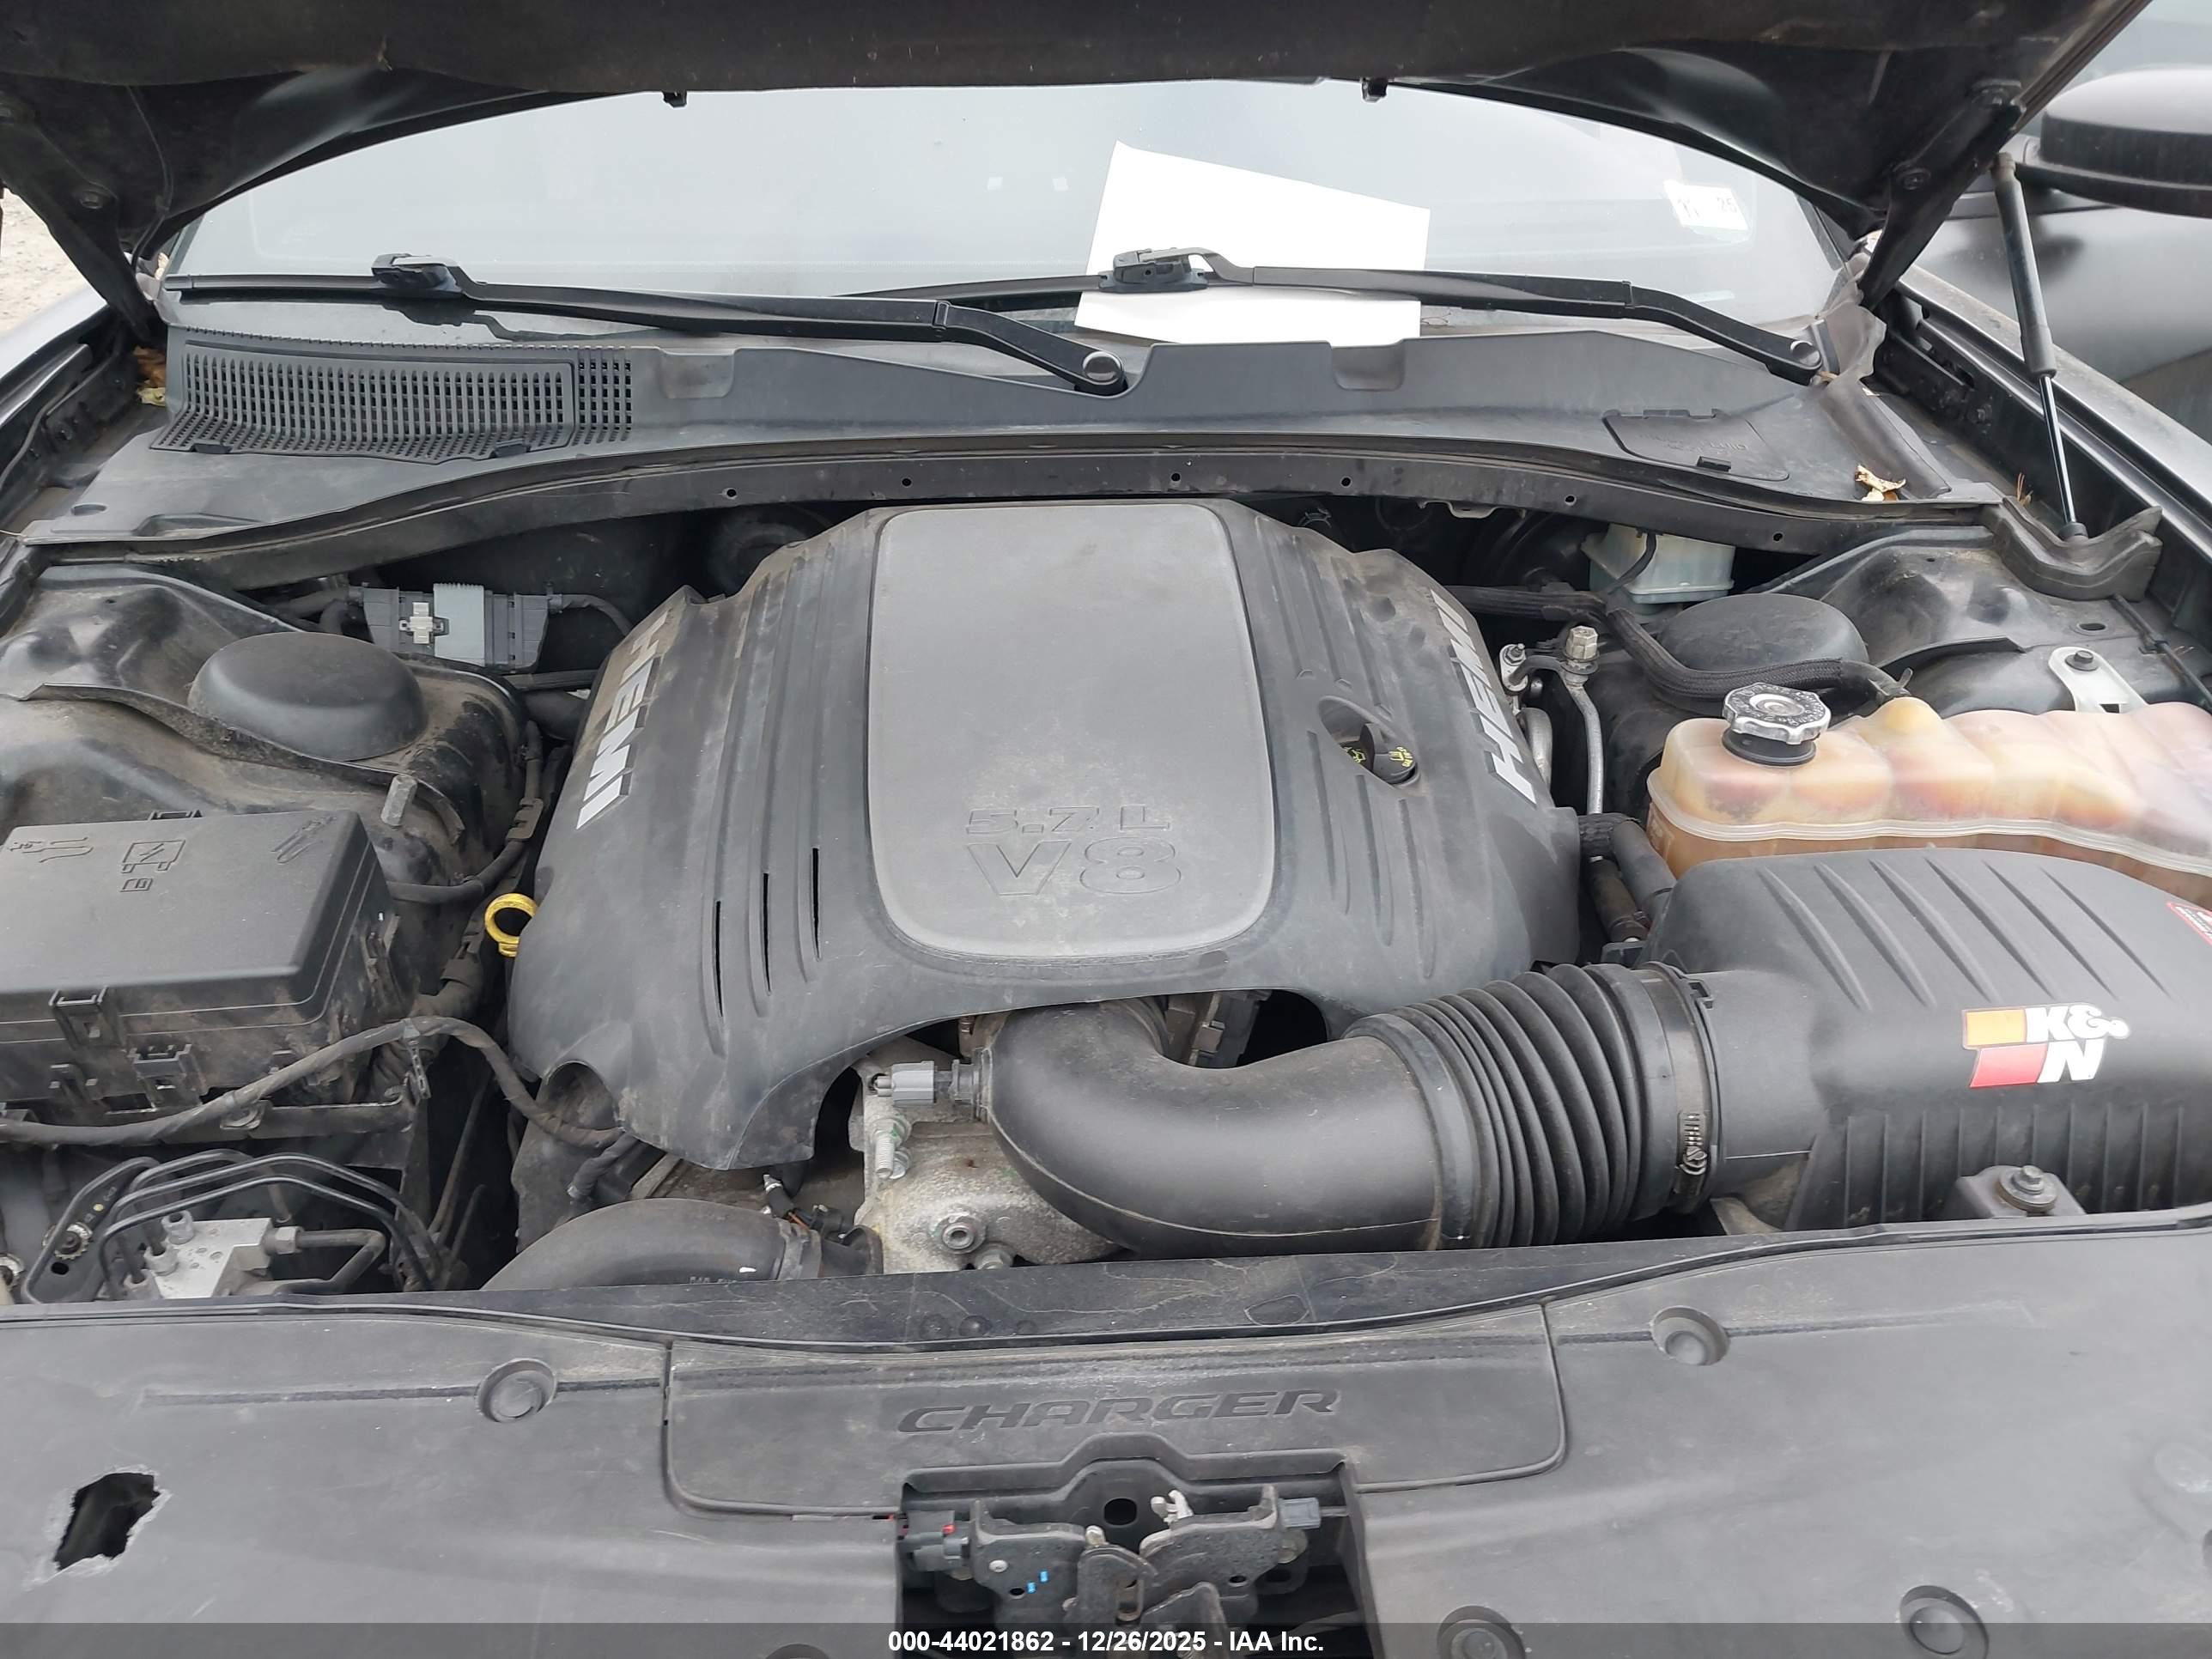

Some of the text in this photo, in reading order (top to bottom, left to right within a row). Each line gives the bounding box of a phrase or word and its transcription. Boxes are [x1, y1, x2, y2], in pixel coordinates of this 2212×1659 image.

[1717, 197, 1738, 213] 25
[576, 609, 671, 830] HEMI
[1431, 589, 1537, 805] HEMI
[967, 836, 1182, 896] V8
[897, 1389, 1341, 1433] CHARGER
